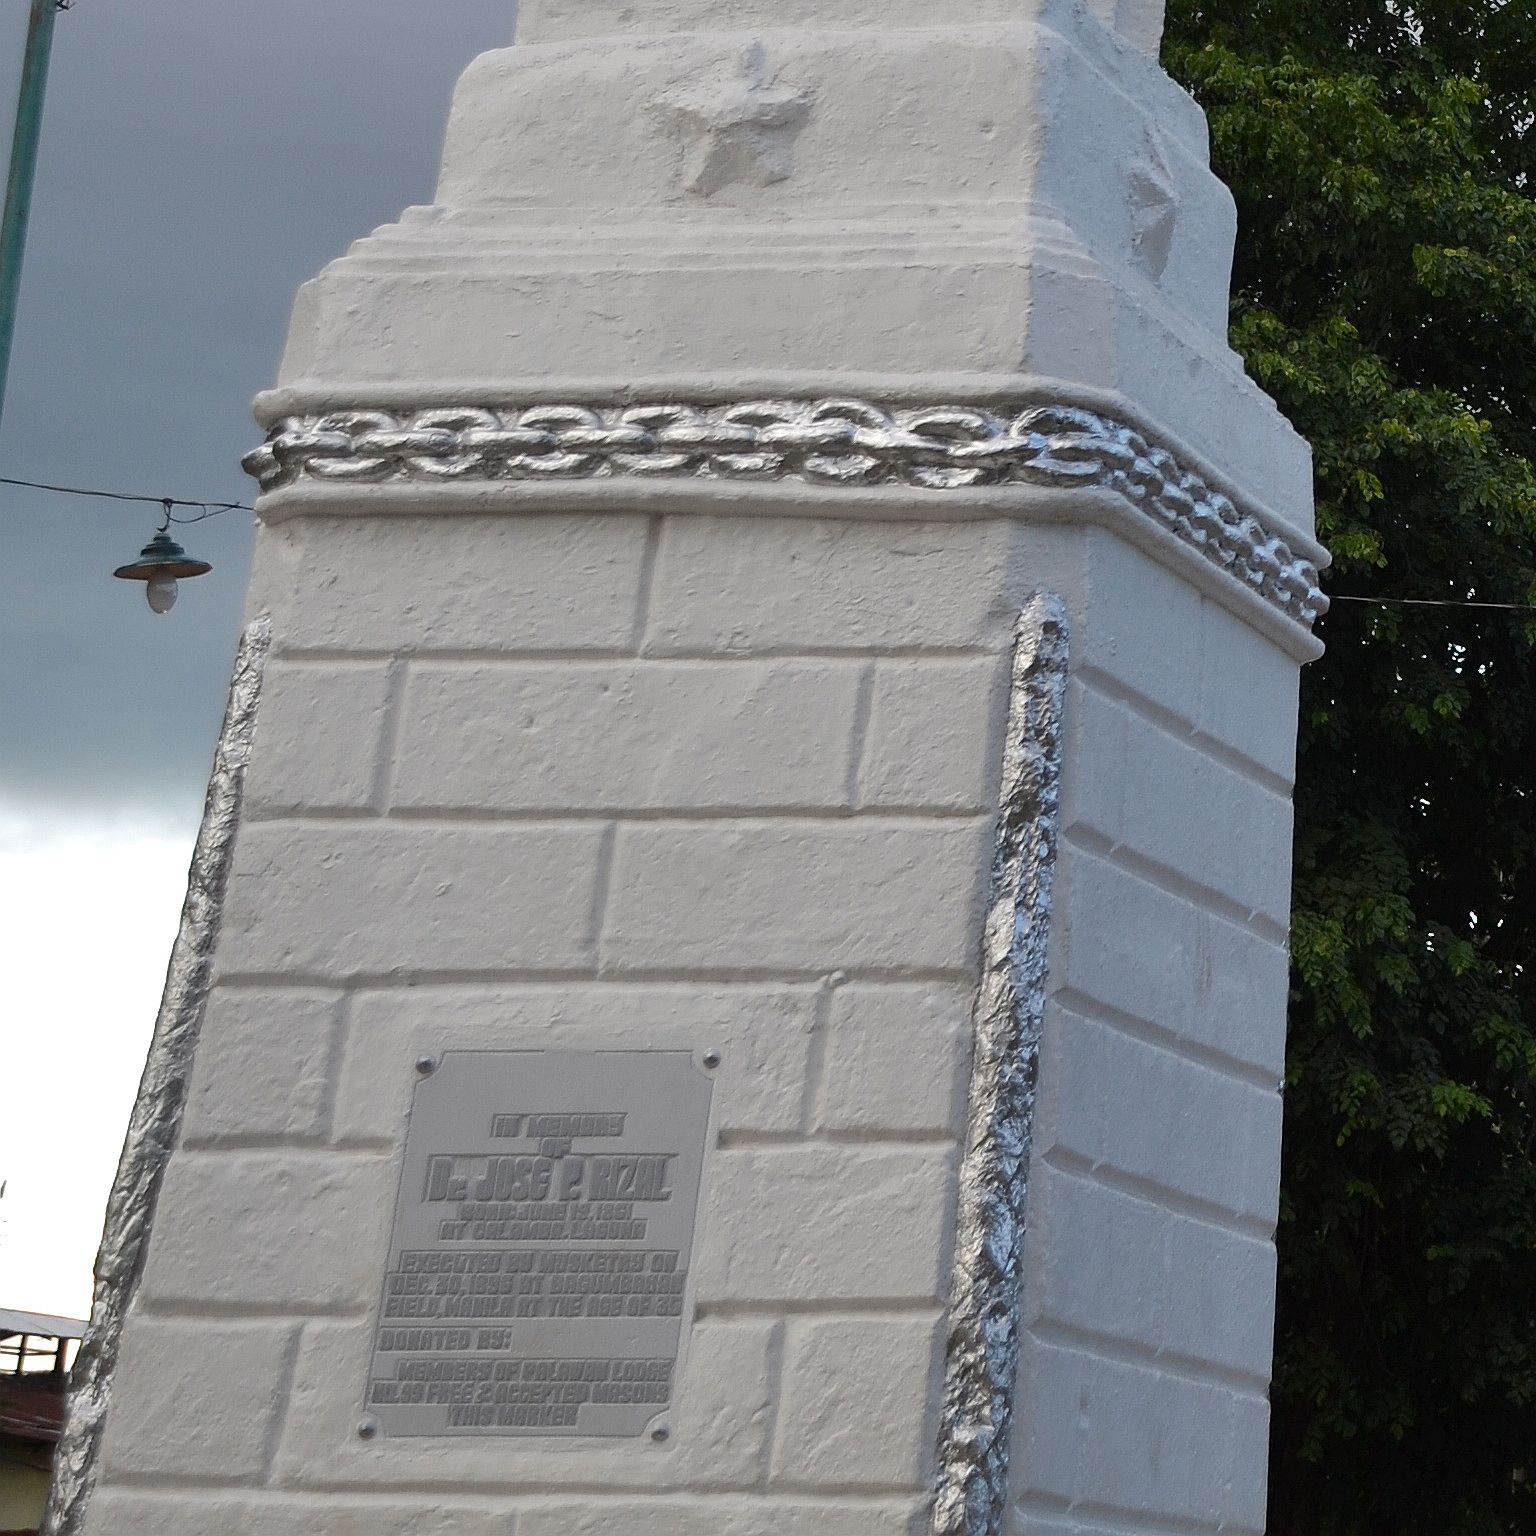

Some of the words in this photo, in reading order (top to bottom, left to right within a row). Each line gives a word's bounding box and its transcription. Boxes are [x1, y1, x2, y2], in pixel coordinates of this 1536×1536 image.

[525, 1114, 626, 1138] MEMORY
[540, 1137, 573, 1158] OF
[474, 1156, 553, 1202] JOSE
[587, 1155, 674, 1202] RIZAL
[402, 1251, 500, 1273] EXECUTED
[549, 1295, 584, 1317] THE
[379, 1328, 471, 1352] DONATED
